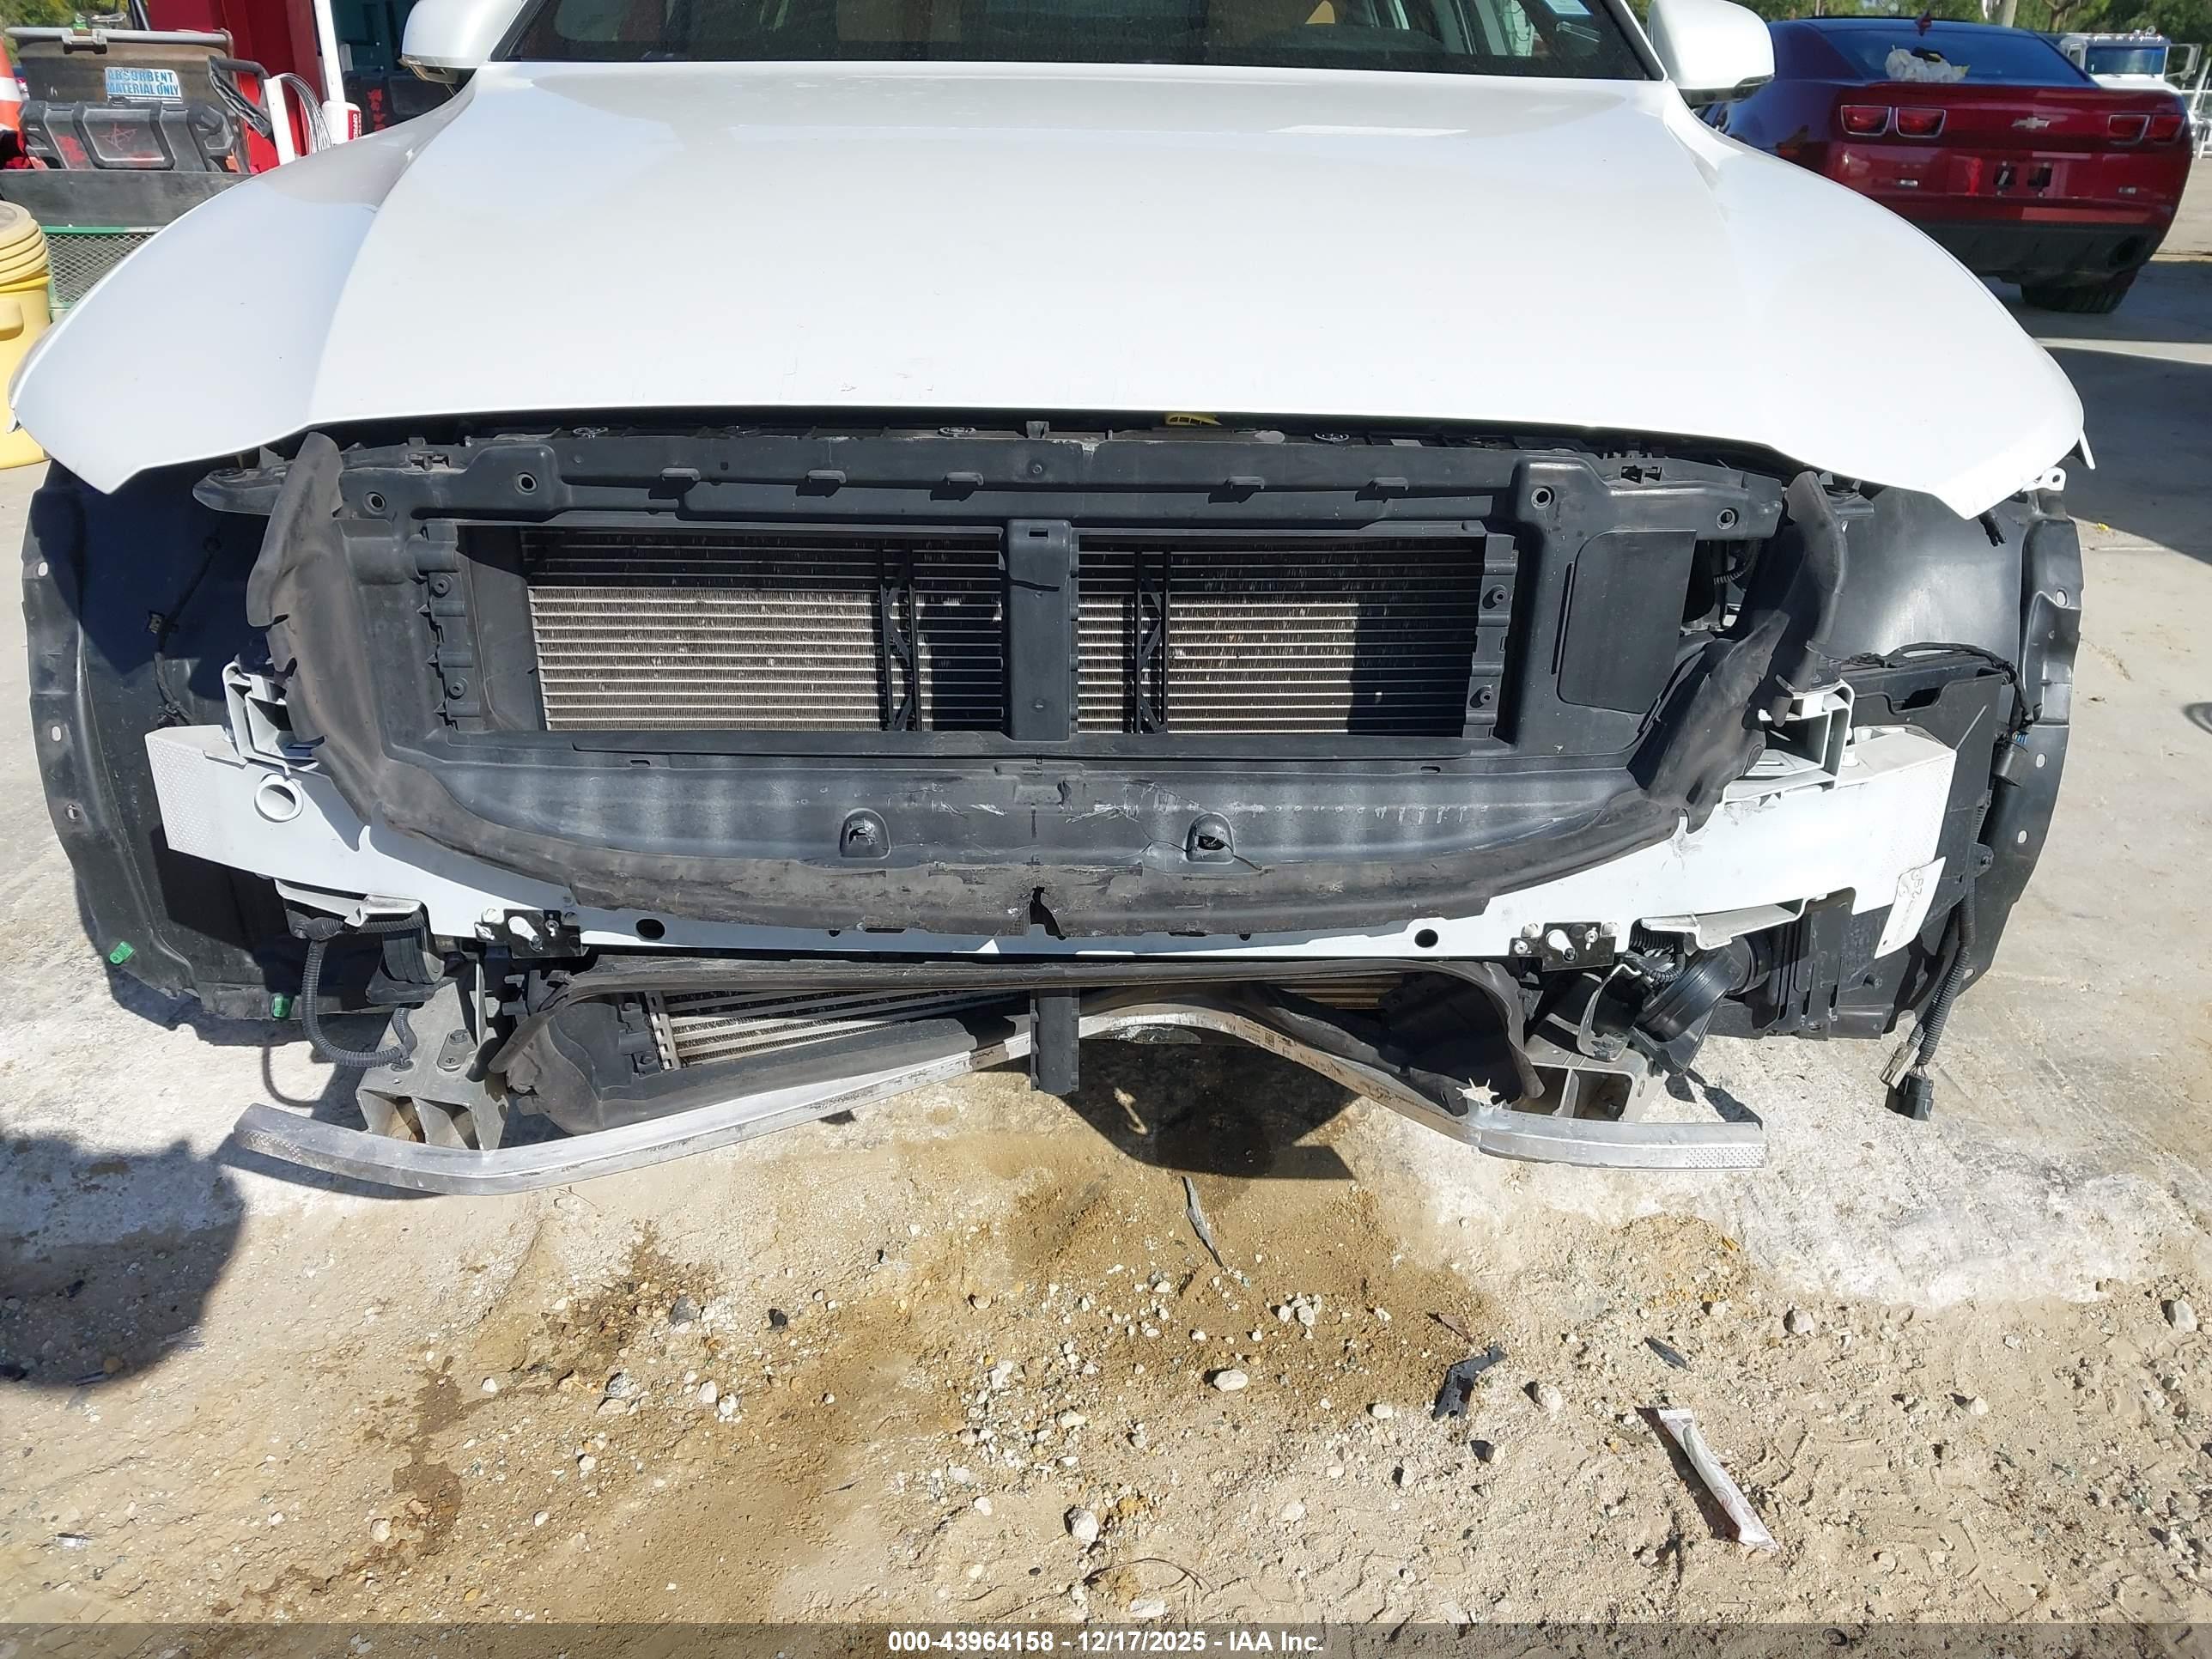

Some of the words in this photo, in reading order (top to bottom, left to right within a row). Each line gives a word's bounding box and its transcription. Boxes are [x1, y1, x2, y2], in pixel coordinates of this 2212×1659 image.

[108, 70, 173, 83] ABSORBENT
[107, 82, 155, 94] MATERIAL
[157, 84, 179, 95] ONLY
